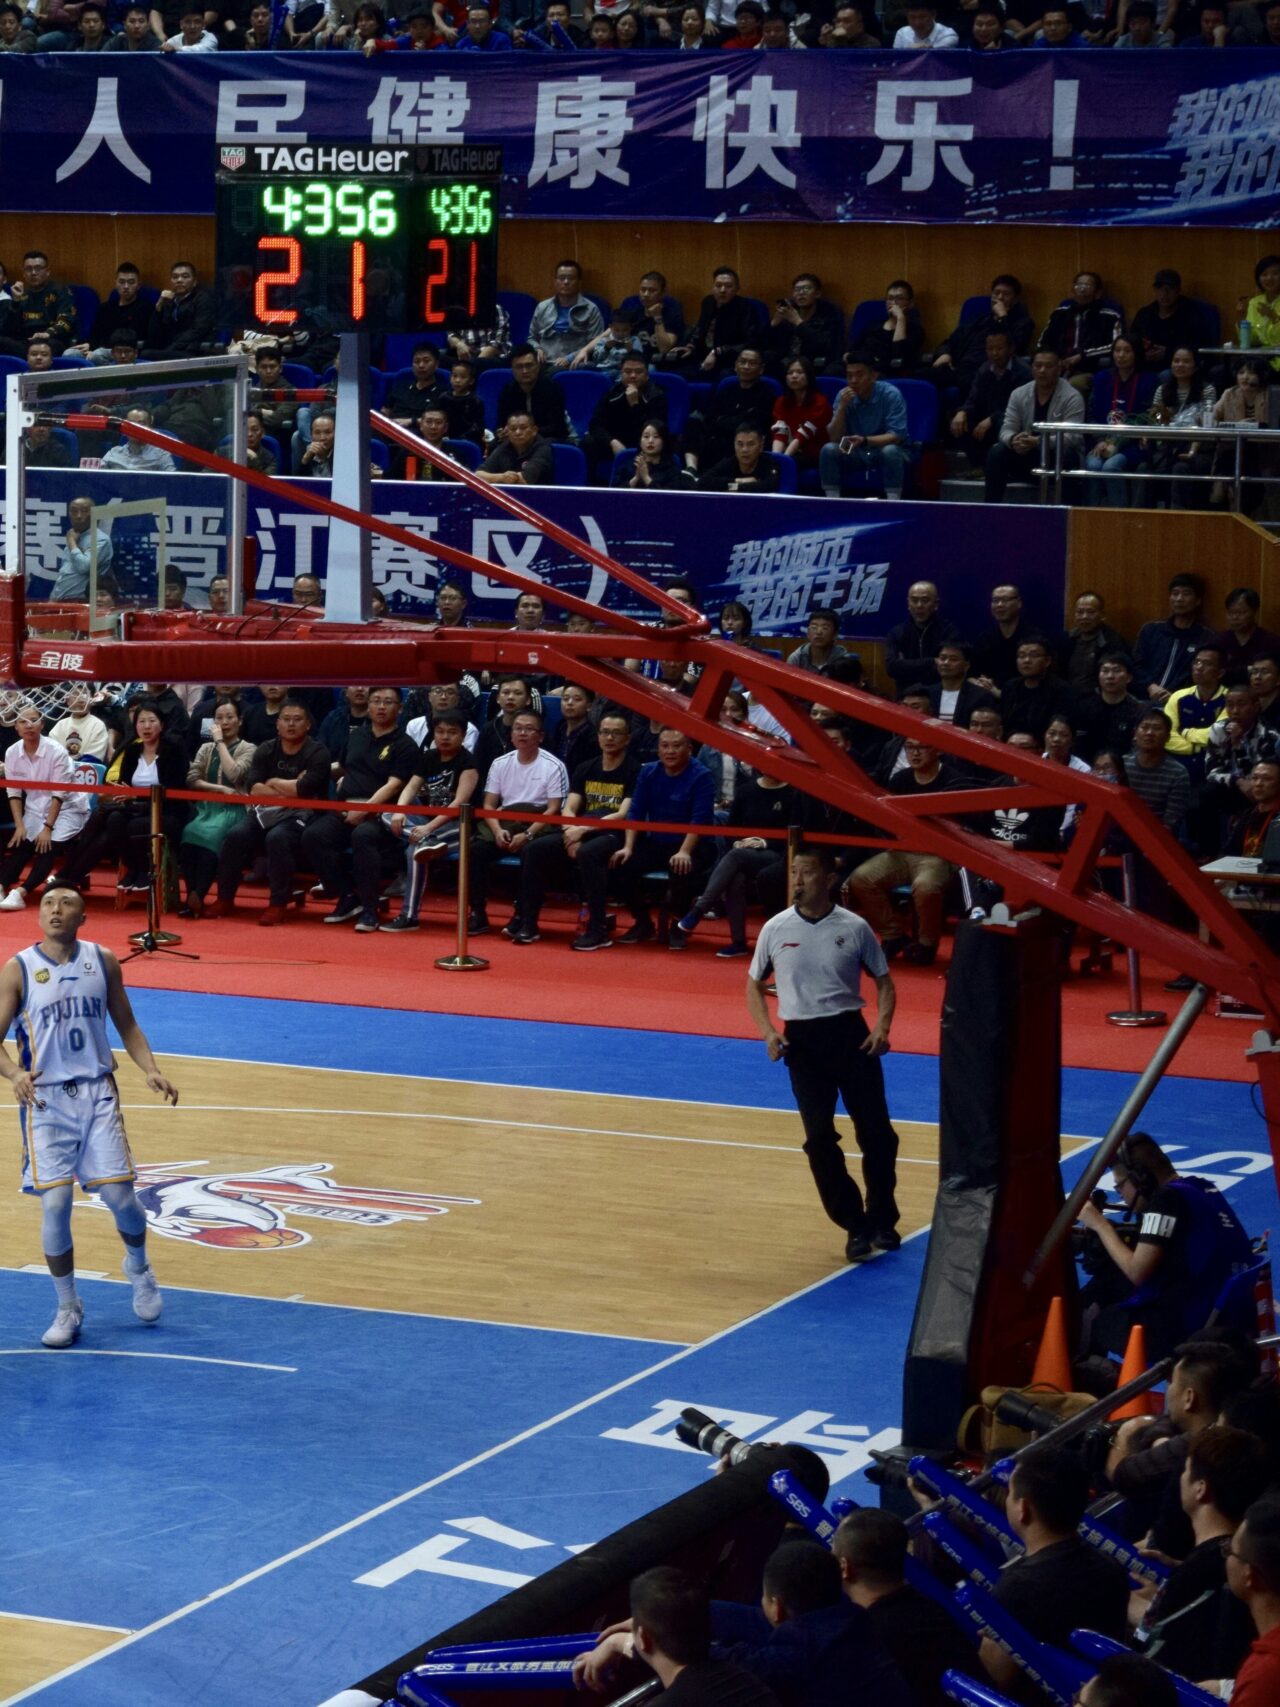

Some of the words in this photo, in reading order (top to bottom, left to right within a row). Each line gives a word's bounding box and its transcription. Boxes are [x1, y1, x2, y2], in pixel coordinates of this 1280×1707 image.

[39, 650, 85, 672] 金陵
[39, 995, 103, 1030] FUJIAN
[68, 1027, 85, 1052] 0
[785, 1492, 812, 1519] SBS
